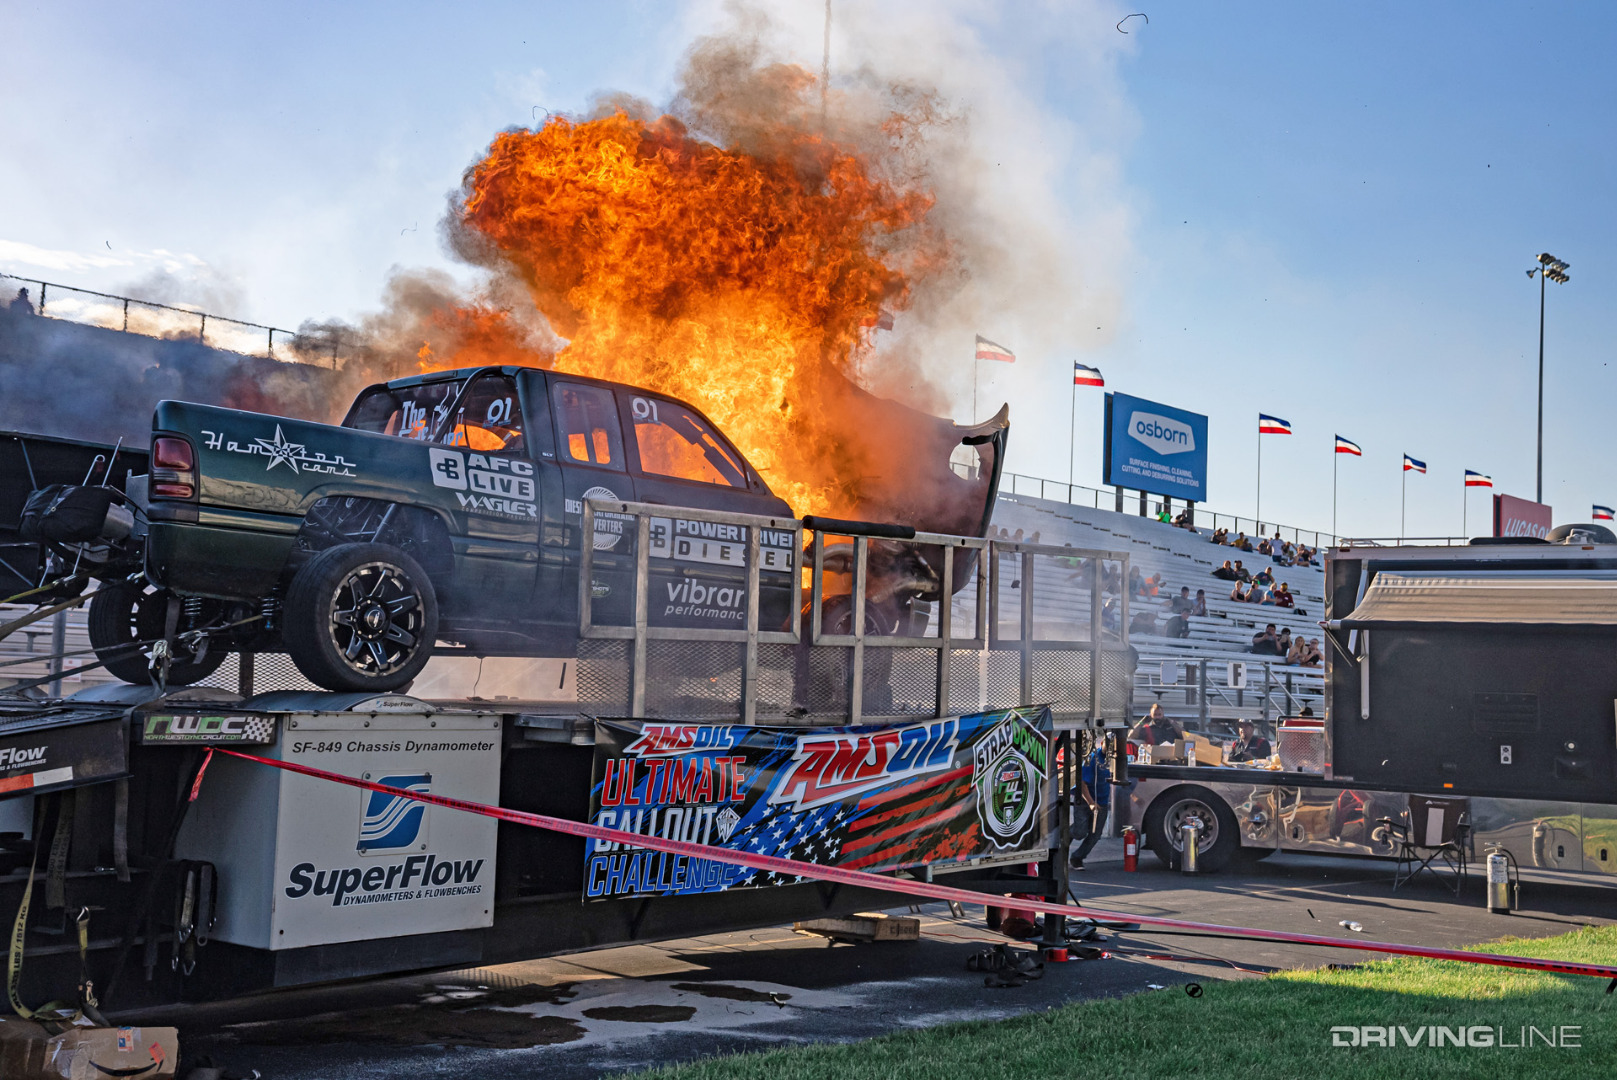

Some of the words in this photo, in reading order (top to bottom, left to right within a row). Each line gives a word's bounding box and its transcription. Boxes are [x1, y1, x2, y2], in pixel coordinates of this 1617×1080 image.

[401, 400, 426, 430] The
[487, 397, 512, 423] 01
[632, 397, 659, 421] 01
[1136, 420, 1188, 445] osborn
[301, 462, 356, 477] cams
[467, 453, 534, 476] AFC
[1129, 458, 1149, 468] SURFACE
[472, 473, 530, 497] LIVE
[1141, 469, 1152, 478] AND
[1176, 476, 1199, 487] SOLUTIONS
[455, 492, 537, 517] WAGLER
[676, 520, 739, 541] POWER
[664, 604, 744, 620] performanc
[1232, 662, 1242, 687] F
[292, 742, 342, 753] SF-849
[346, 741, 401, 752] Chassis
[404, 740, 494, 753] Dynamometer
[623, 724, 735, 758] AMSOIL
[977, 718, 1012, 775] STRAP
[1012, 719, 1046, 771] DOWN
[769, 717, 960, 812] AMSOIL
[601, 756, 746, 806] ULTIMATE
[285, 855, 484, 906] SuperFlow
[587, 852, 735, 897] CHALLENGE
[343, 890, 414, 906] DYNAMOMETERS
[415, 889, 422, 899] &
[424, 885, 482, 898] FLOWBENCHES
